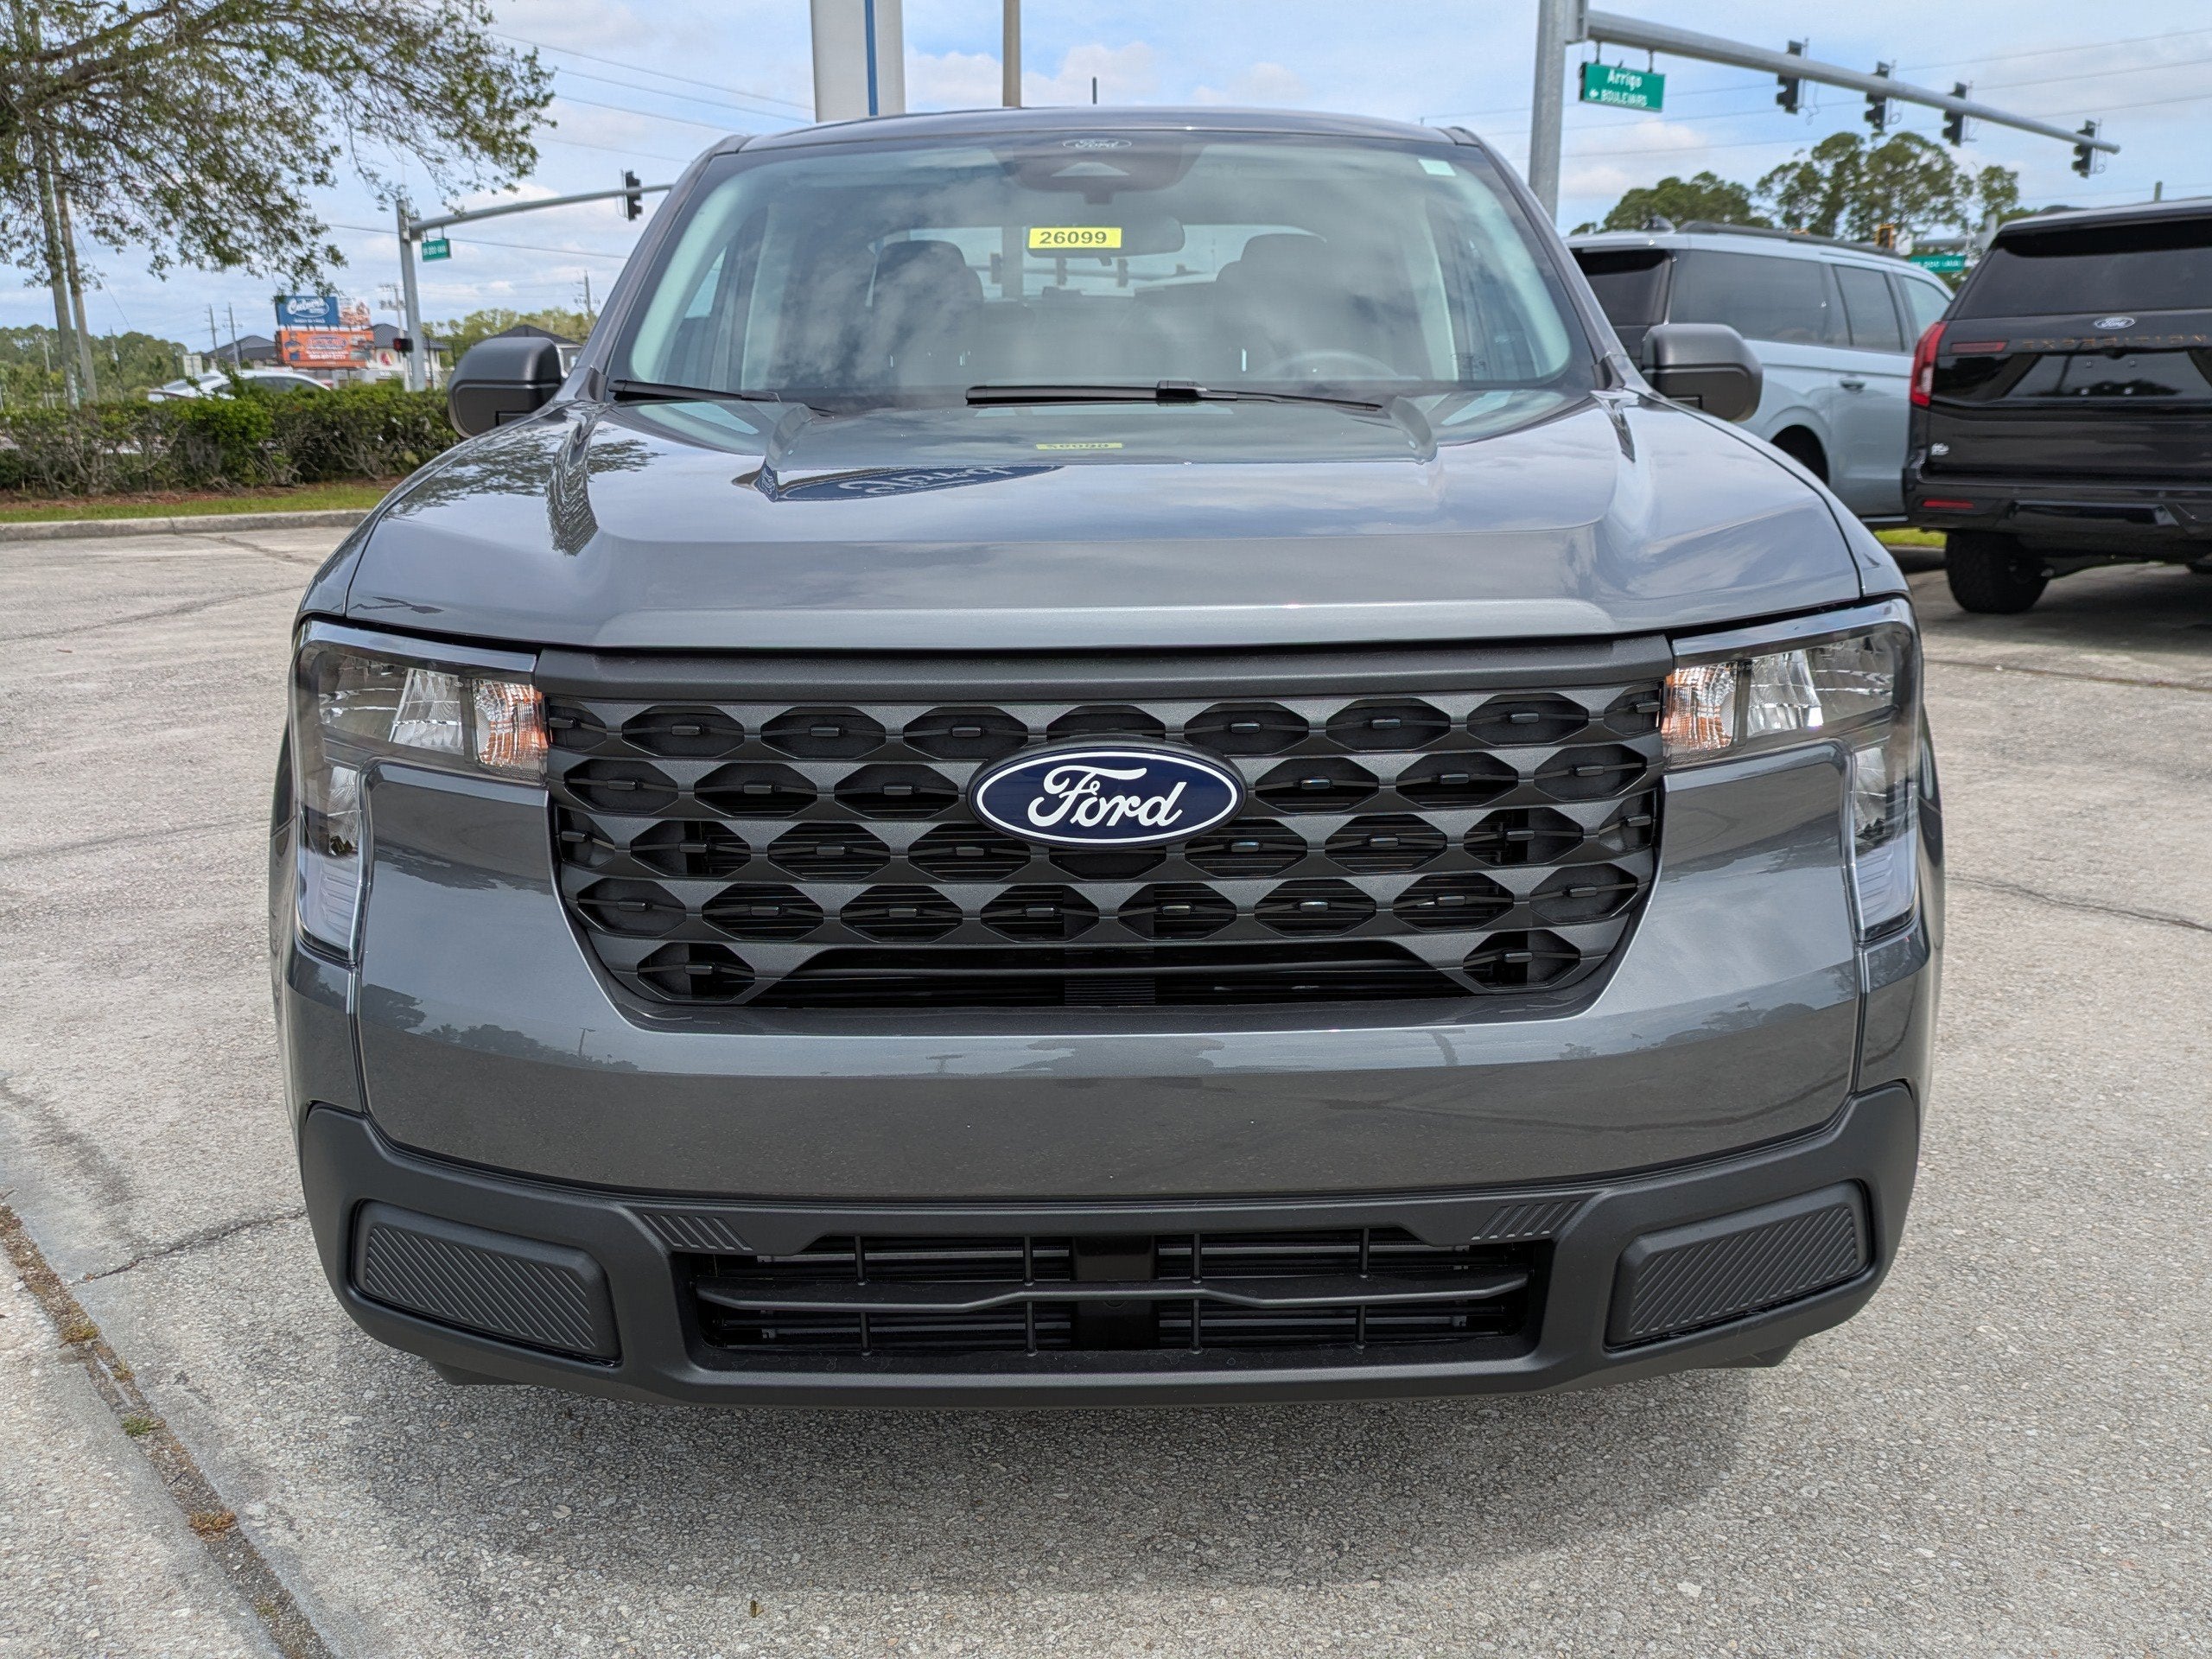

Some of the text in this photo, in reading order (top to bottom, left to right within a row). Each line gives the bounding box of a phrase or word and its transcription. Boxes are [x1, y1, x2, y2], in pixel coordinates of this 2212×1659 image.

[1607, 68, 1643, 91] Arrigo
[1600, 88, 1648, 107] BOULEVARD
[1039, 231, 1107, 245] 26099
[1027, 765, 1187, 827] Ford
